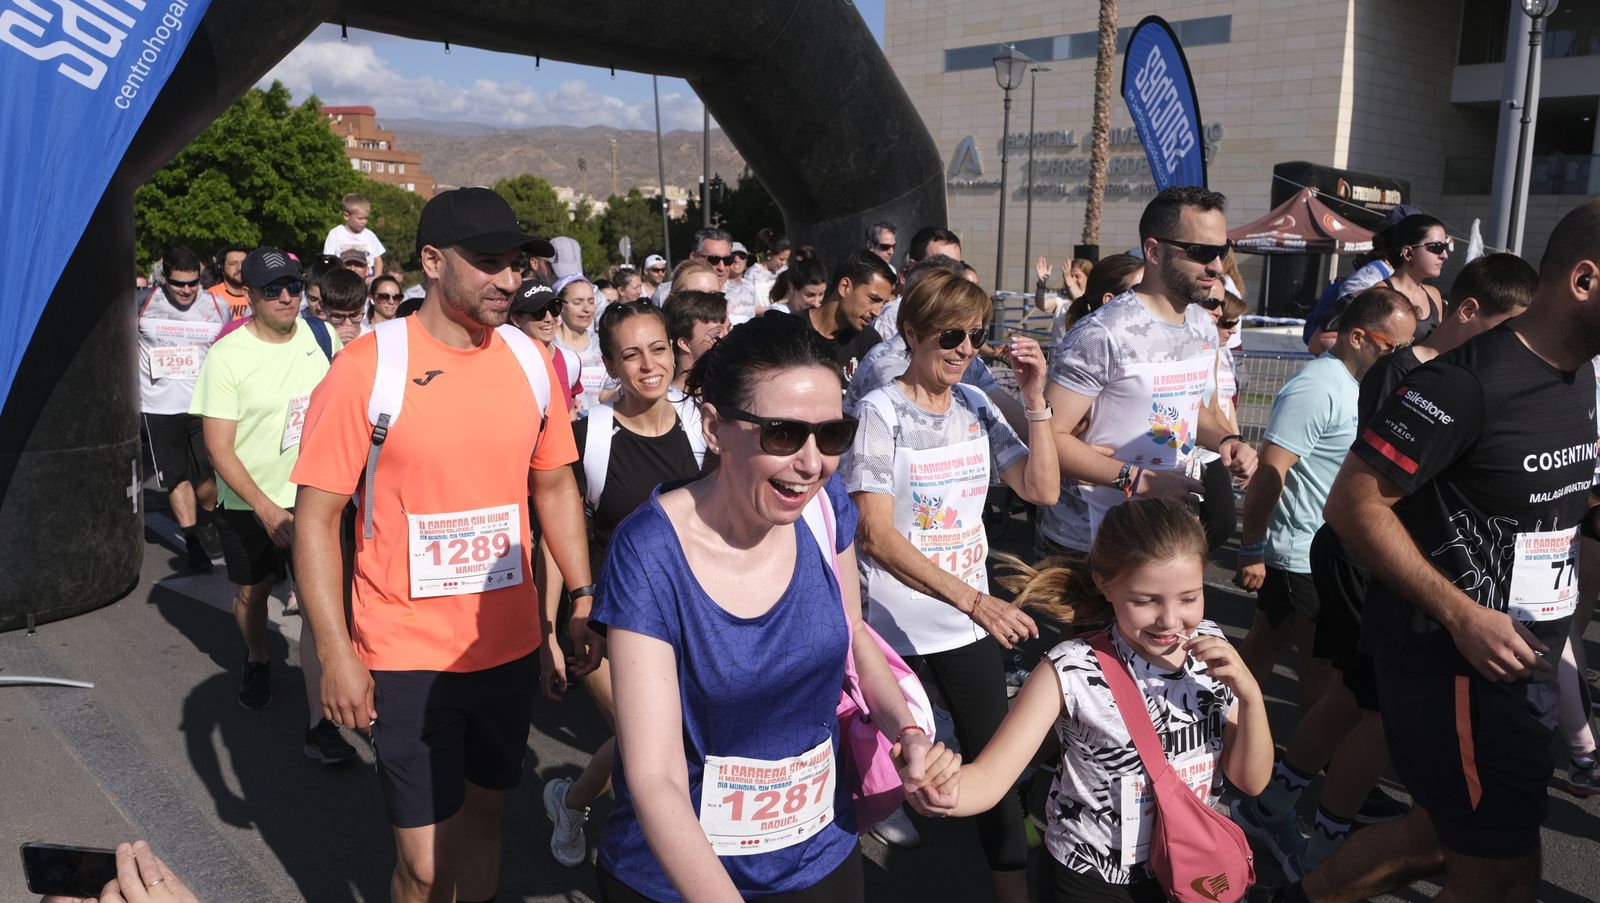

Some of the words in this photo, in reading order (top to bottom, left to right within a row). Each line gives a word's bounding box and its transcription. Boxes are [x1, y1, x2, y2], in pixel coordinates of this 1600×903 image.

[157, 357, 194, 367] 1296
[1523, 442, 1599, 472] COSENTINO
[419, 521, 426, 530] II
[427, 517, 469, 530] CARRERA
[471, 515, 486, 526] SIN
[487, 511, 509, 524] HUMO
[425, 532, 511, 566] 1289
[928, 543, 984, 572] 1130
[455, 563, 487, 575] MANUEL
[1551, 556, 1576, 590] 77
[1157, 707, 1222, 756] PUMA
[731, 764, 787, 779] CARRERA
[1190, 762, 1206, 775] SIN
[723, 767, 830, 821] 1287
[729, 783, 757, 791] MUNDIAL
[760, 815, 798, 831] RAQUEL
[1207, 872, 1230, 897] NIKE
